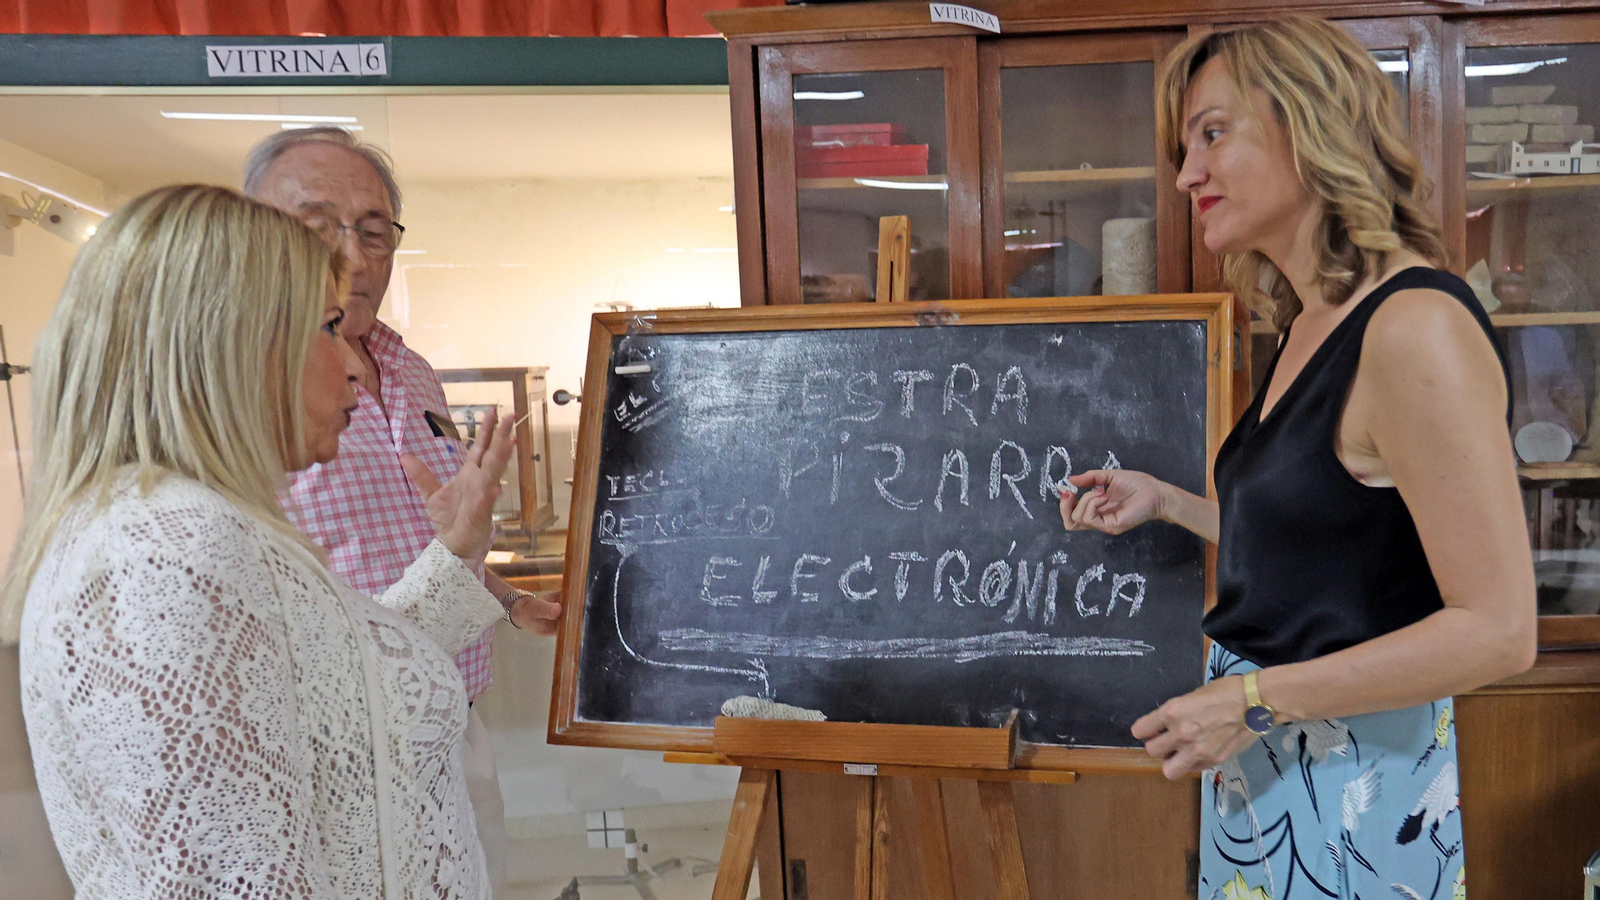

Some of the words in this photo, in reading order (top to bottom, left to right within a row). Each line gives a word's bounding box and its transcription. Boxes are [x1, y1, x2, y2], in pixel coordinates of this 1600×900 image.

[933, 6, 995, 28] VITRINA
[212, 49, 352, 73] VITRINA
[365, 46, 380, 71] 6
